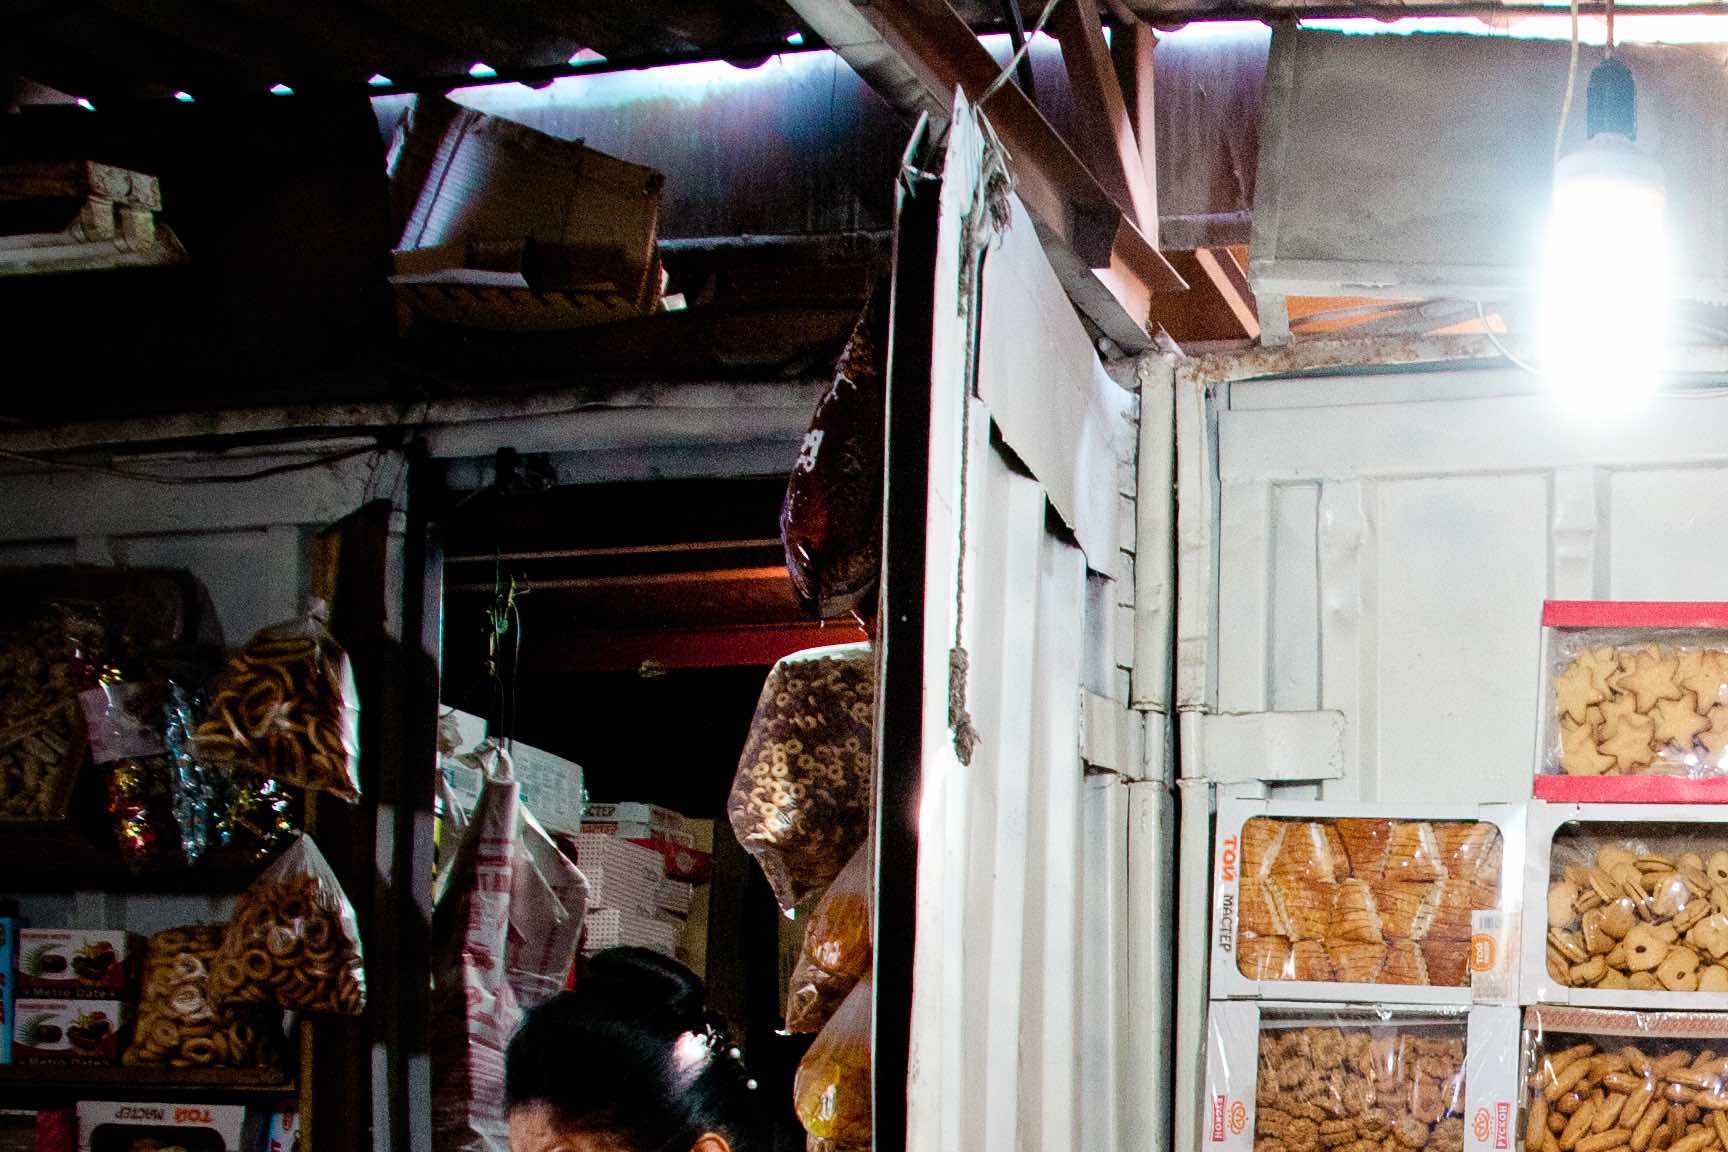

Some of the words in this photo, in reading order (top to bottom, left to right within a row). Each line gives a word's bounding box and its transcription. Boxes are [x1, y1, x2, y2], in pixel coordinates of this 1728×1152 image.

[1222, 835, 1238, 881] ТОЙ
[1219, 895, 1235, 953] МАСТЕР
[114, 1106, 164, 1120] МАСТЕР
[174, 1107, 211, 1123] ТОЙ
[1497, 1103, 1509, 1147] РУСКОН
